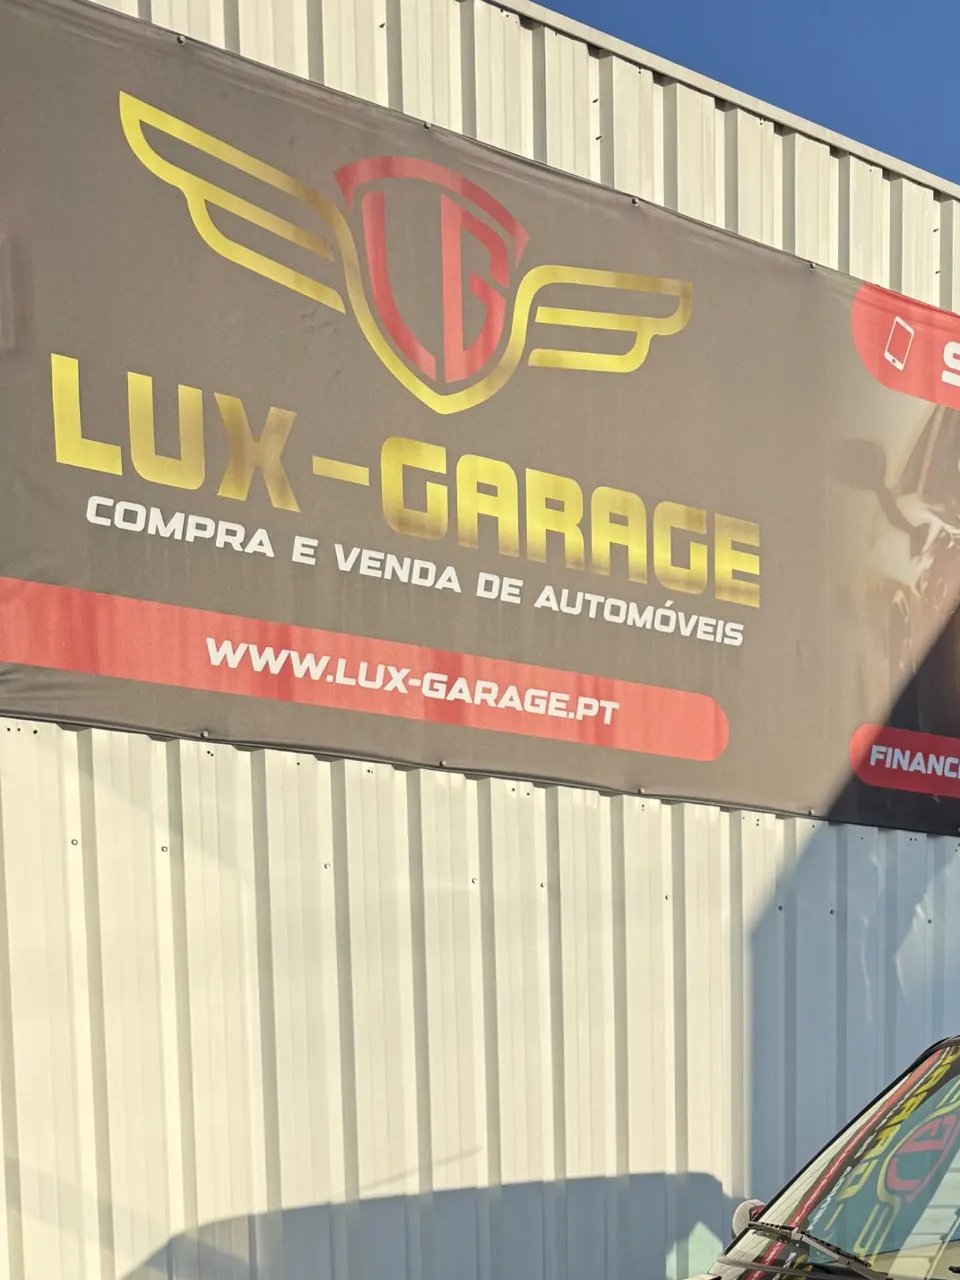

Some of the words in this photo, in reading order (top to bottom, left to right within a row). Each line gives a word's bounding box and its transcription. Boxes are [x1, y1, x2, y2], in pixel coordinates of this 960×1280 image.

[86, 495, 275, 557] COMPRA
[291, 535, 319, 565] E
[334, 543, 461, 593] VENDA
[476, 571, 523, 604] DE
[534, 585, 745, 647] AUTOMÓVEIS
[206, 637, 620, 725] WWW.LUX-GARAGE.PT
